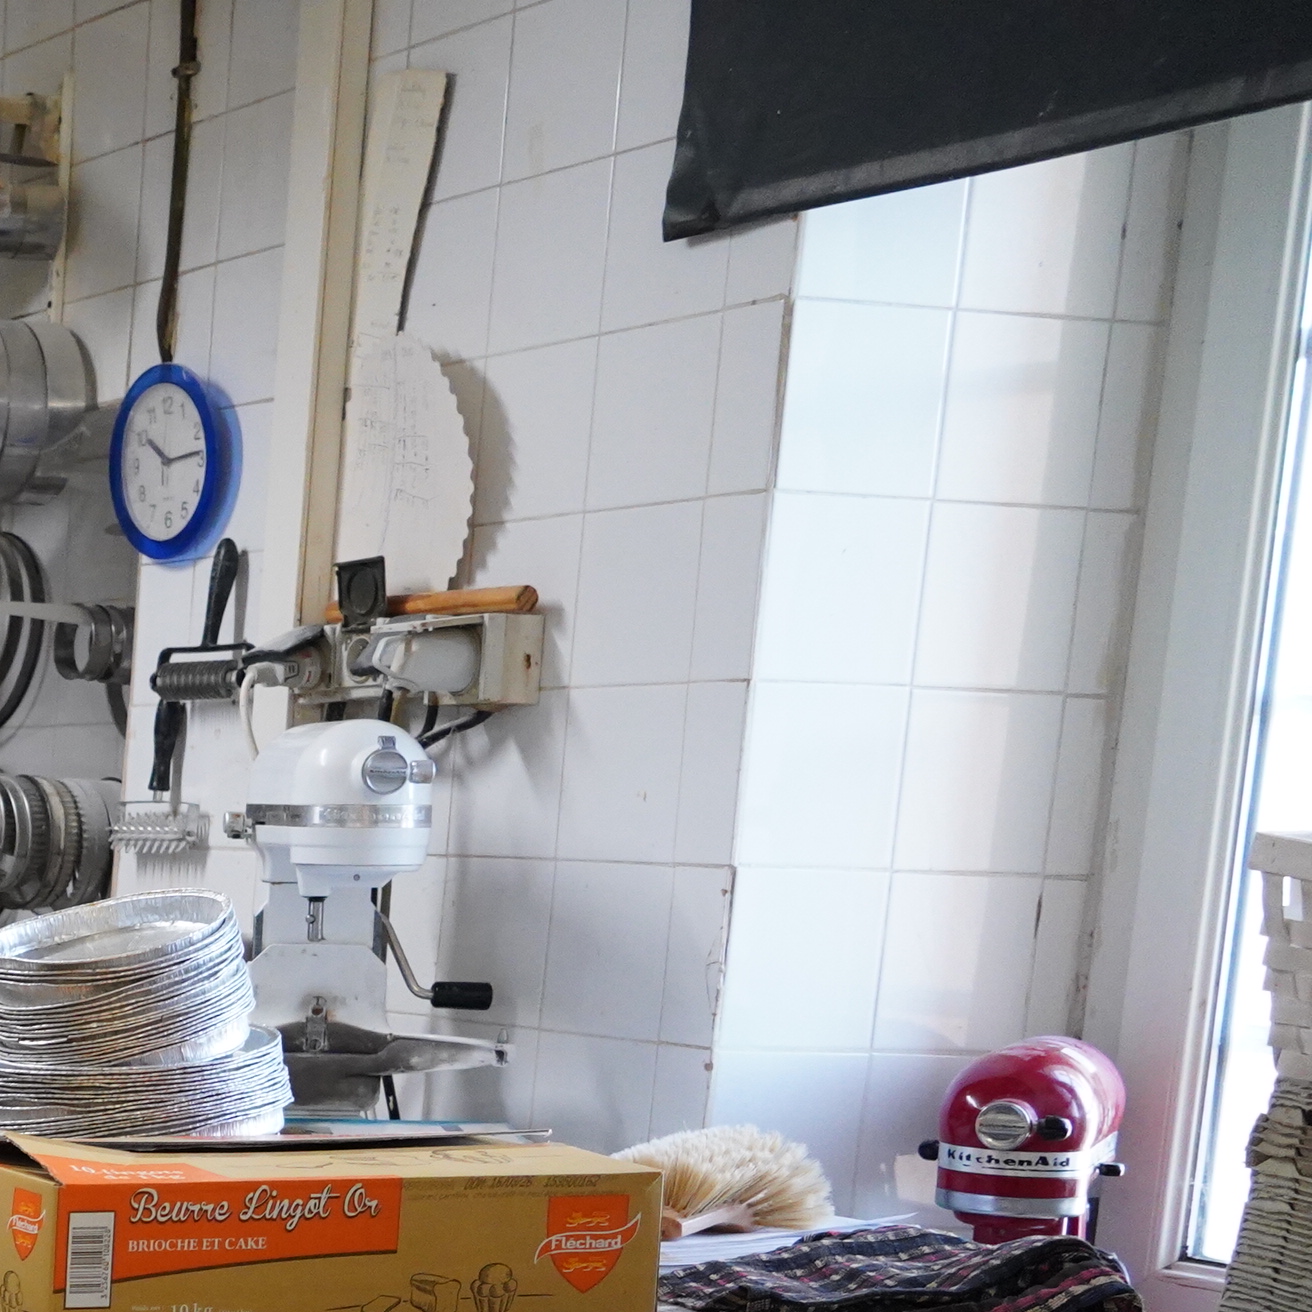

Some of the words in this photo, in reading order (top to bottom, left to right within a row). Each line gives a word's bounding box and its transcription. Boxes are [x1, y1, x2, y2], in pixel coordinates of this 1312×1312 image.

[146, 405, 157, 424] 11
[162, 396, 174, 415] 12
[179, 402, 186, 420] 1
[193, 422, 202, 441] 2
[132, 458, 140, 476] 9
[197, 450, 205, 468] 3
[138, 485, 147, 502] 8
[192, 479, 201, 497] 4
[149, 504, 157, 524] 7
[180, 501, 189, 520] 5
[164, 511, 174, 529] 6
[947, 1148, 1070, 1167] KitchenAid
[129, 1187, 231, 1223] Beurre
[238, 1183, 340, 1231] Lingot
[342, 1182, 381, 1218] Or
[128, 1239, 198, 1252] BRIOCHE
[202, 1238, 222, 1251] ET
[225, 1237, 267, 1250] CAKE
[550, 1235, 623, 1250] Fléchard
